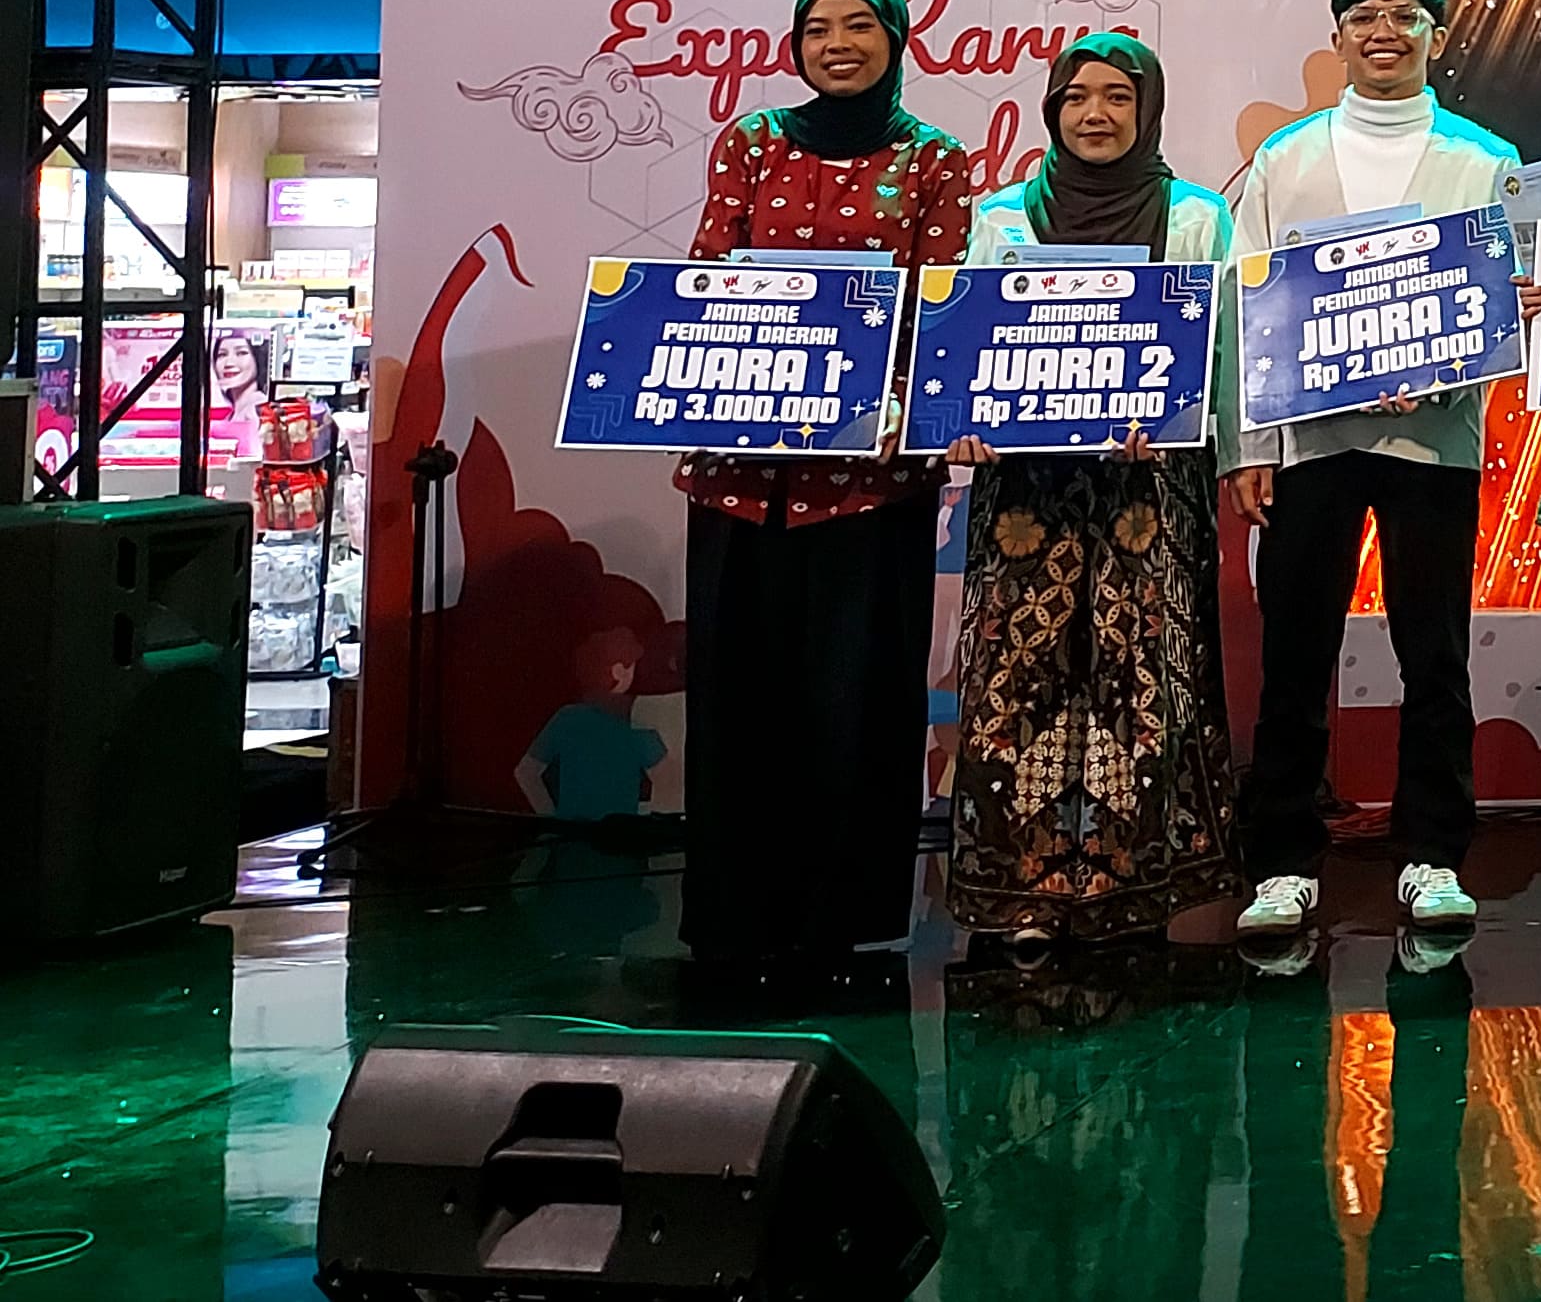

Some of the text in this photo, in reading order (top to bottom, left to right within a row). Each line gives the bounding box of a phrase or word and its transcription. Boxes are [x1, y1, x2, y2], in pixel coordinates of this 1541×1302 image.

[1343, 254, 1430, 289] JAMBORE
[1312, 266, 1468, 315] PEMUDA DAERAH
[701, 302, 799, 324] JAMBORE
[1027, 303, 1121, 323] JAMBORE
[1298, 285, 1487, 362] JUARA 3
[662, 322, 839, 346] PEMUDA DAERAH
[992, 323, 1158, 345] PEMUDA DAERAH
[641, 345, 844, 393] JUARA 1
[969, 345, 1173, 393] JUARA 2
[1303, 328, 1485, 393] Rp 2.000.000
[634, 391, 841, 426] Rp 3.000.000
[971, 391, 1166, 428] Rp 2.500.000
